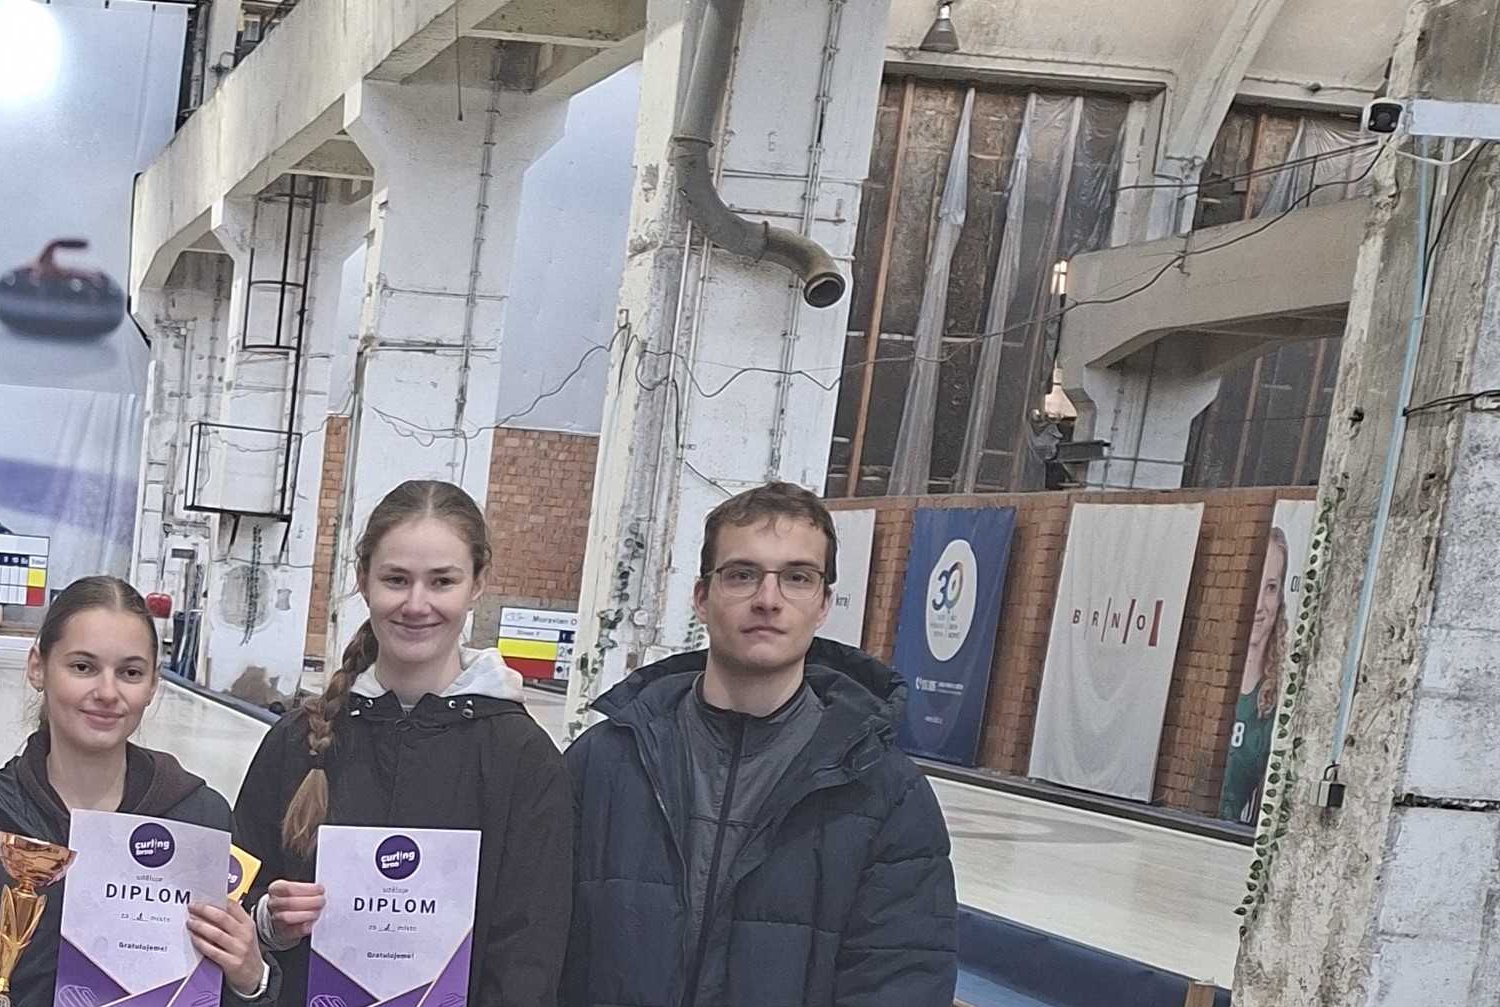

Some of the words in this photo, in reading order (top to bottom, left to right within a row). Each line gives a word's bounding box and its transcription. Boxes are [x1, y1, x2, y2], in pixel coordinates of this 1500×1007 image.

[932, 561, 964, 611] 30
[532, 615, 568, 625] Moravian
[1231, 721, 1245, 748] 8
[105, 883, 191, 905] DIPLOM
[353, 897, 436, 914] DIPLOM
[118, 941, 168, 953] Gratulujeme!
[367, 952, 415, 961] Gratulujeme!
